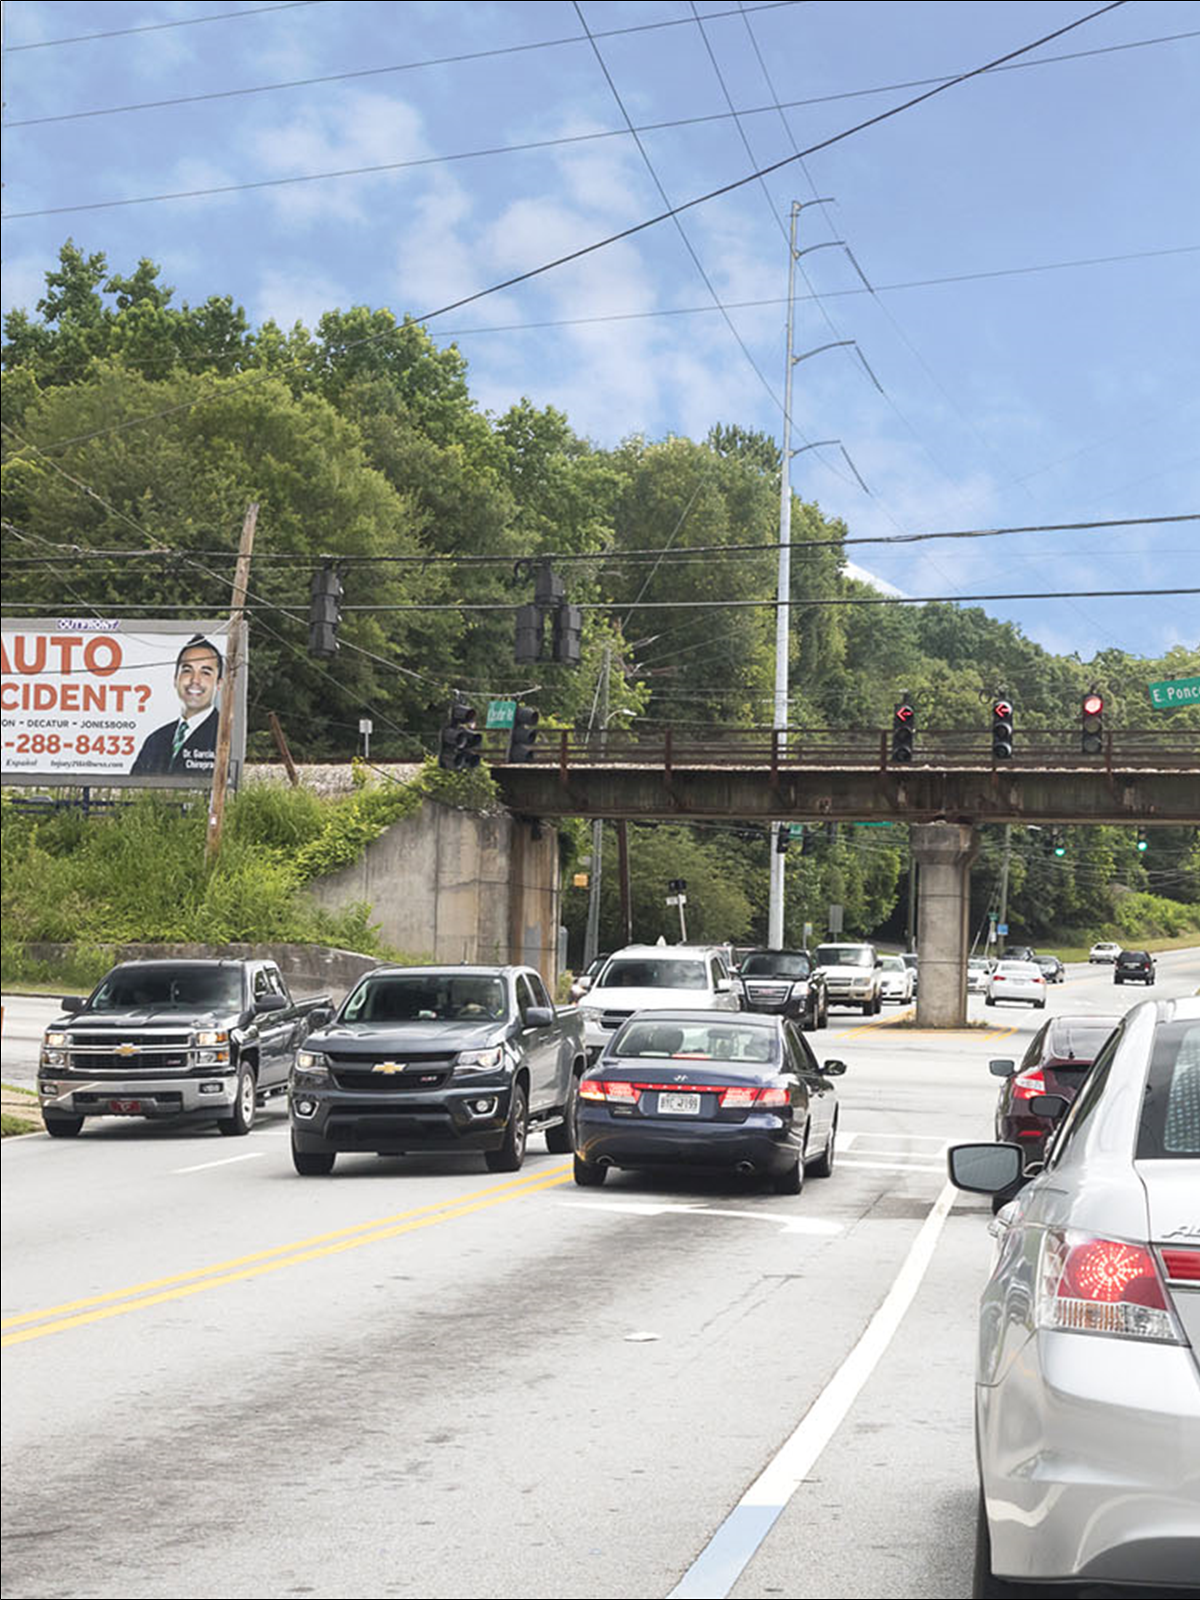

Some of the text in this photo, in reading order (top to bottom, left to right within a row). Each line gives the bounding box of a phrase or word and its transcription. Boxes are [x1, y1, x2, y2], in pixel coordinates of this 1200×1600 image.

[1, 682, 152, 713] CIDENT?
[26, 719, 70, 728] DECATUR
[80, 720, 137, 730] JONESBORO
[1, 733, 135, 756] -288-8433
